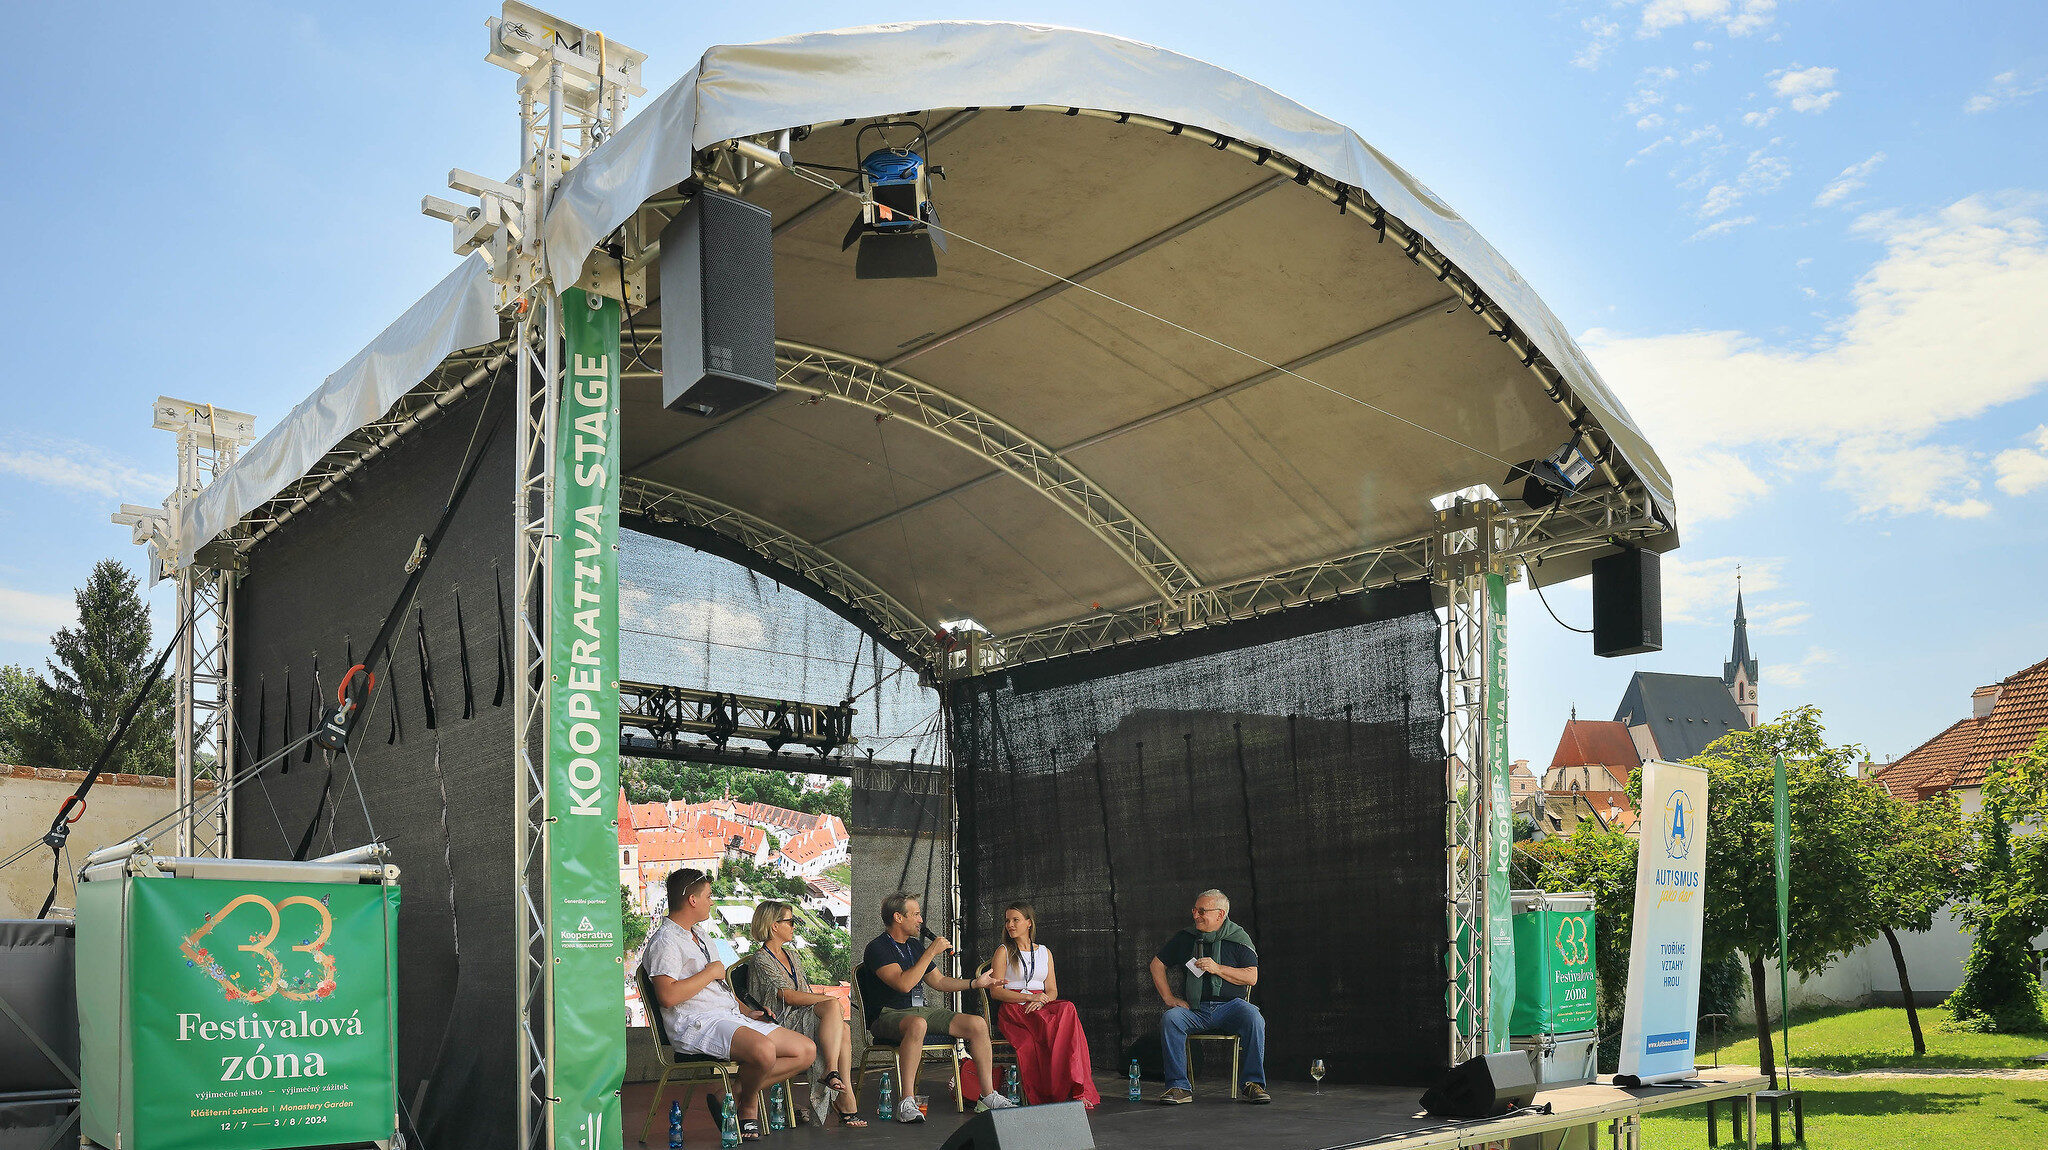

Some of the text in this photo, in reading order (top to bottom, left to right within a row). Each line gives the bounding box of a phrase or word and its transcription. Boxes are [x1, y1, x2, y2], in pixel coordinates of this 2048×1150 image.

[568, 353, 608, 816] KOOPERATIVA STAGE
[1493, 700, 1510, 873] KOOPERATIVA
[1655, 869, 1699, 888] AUTISMUS
[1657, 882, 1694, 909] jako dar
[561, 930, 613, 940] Kooperativa
[1660, 941, 1686, 955] TVOŘÍME
[1661, 960, 1684, 971] VZTAHY
[1554, 968, 1594, 984] Festivalová
[1663, 976, 1680, 987] HROU
[1564, 983, 1587, 1002] zóna
[176, 1009, 364, 1041] Festivalová
[220, 1043, 328, 1082] zóna
[195, 1090, 239, 1101] výjimečné
[240, 1088, 263, 1097] místo
[281, 1084, 321, 1096] výjimečný
[322, 1083, 349, 1092] zážitek
[190, 1107, 231, 1118] Klášterní
[232, 1106, 269, 1115] zahrada
[279, 1101, 322, 1112] Monastery
[323, 1100, 354, 1109] Garden
[220, 1122, 231, 1131] 12
[241, 1121, 248, 1130] 7
[273, 1119, 280, 1127] 3
[289, 1118, 296, 1126] 8
[304, 1115, 328, 1125] 2024
